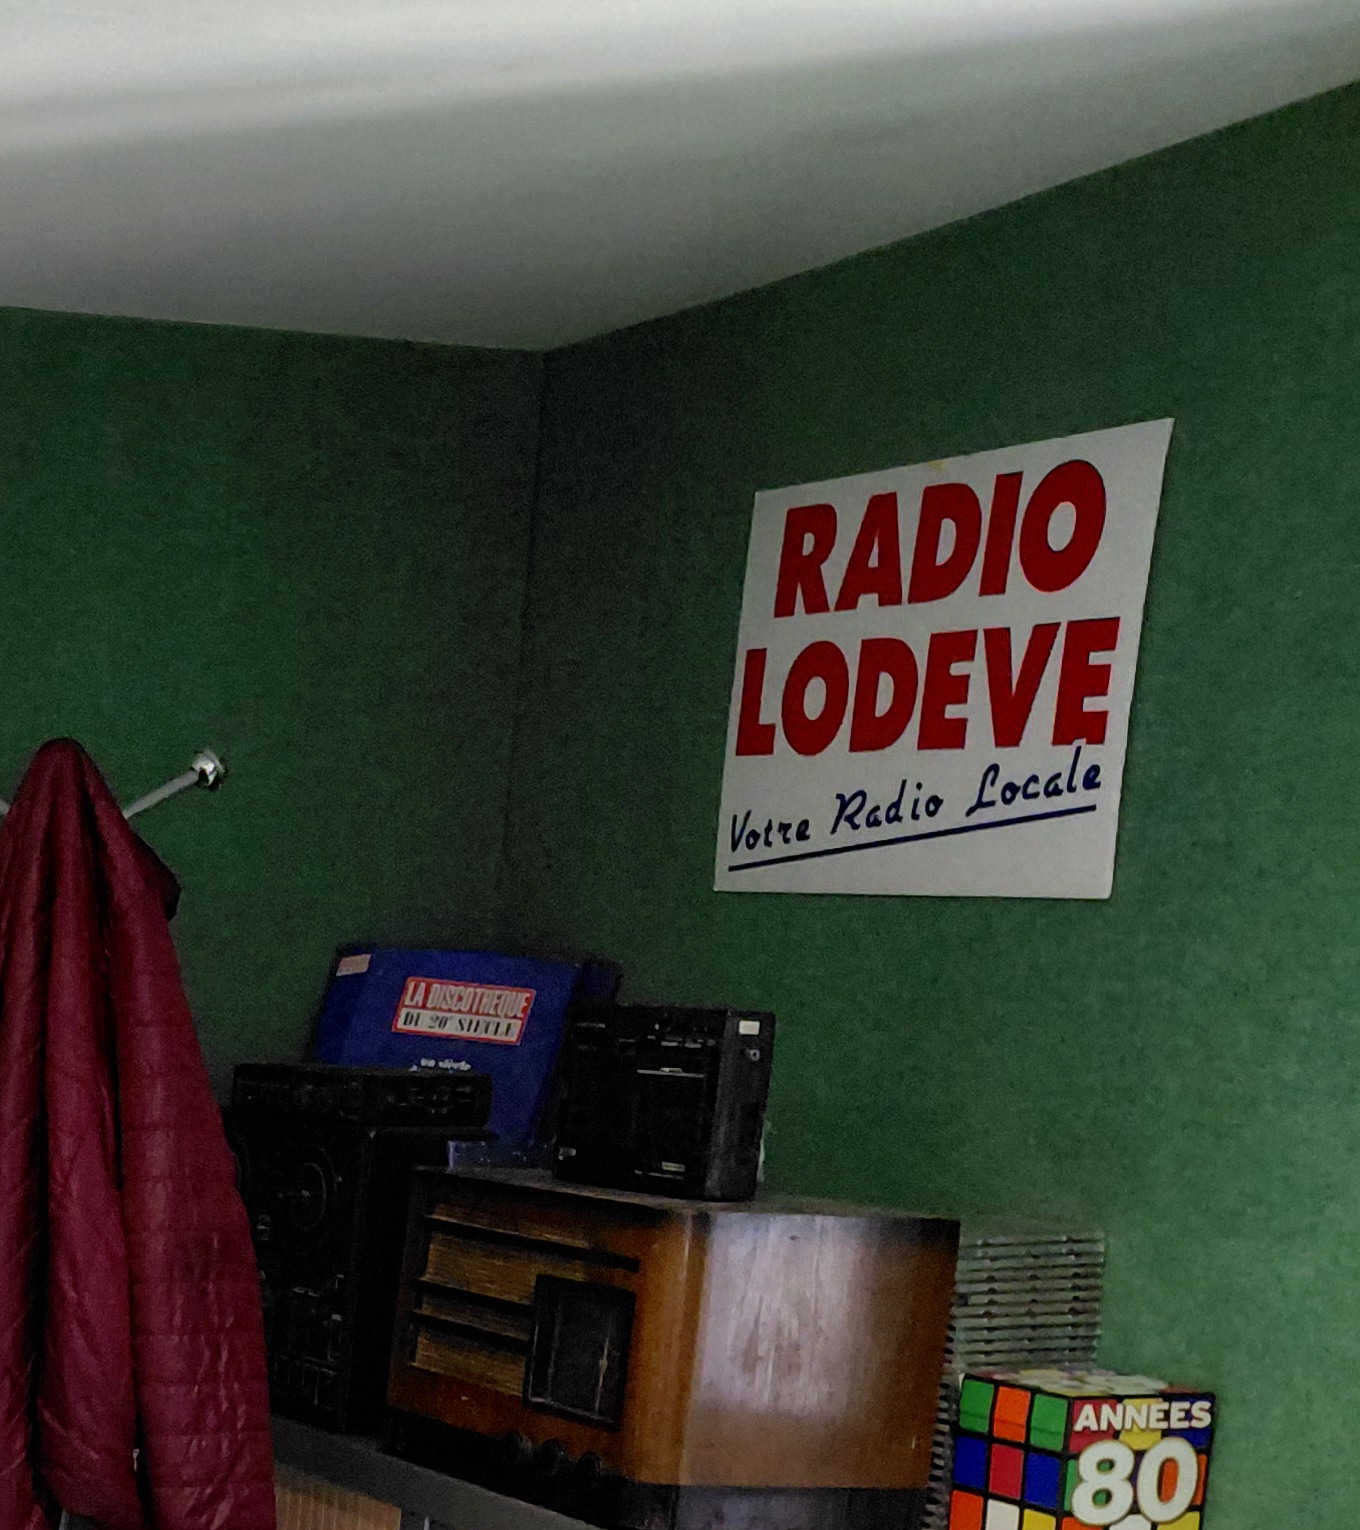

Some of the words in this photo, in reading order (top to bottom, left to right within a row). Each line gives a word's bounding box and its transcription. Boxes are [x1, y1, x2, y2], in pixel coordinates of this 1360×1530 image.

[773, 459, 1107, 618] RADIO
[735, 616, 1121, 756] LODEVE
[729, 810, 811, 853] Votre
[830, 778, 944, 835] Radio
[965, 746, 1102, 818] Locale
[404, 981, 427, 1008] LA
[426, 983, 530, 1019] DISCOTHEQUE
[1073, 1400, 1213, 1432] ANNEES
[1071, 1436, 1199, 1526] 80
